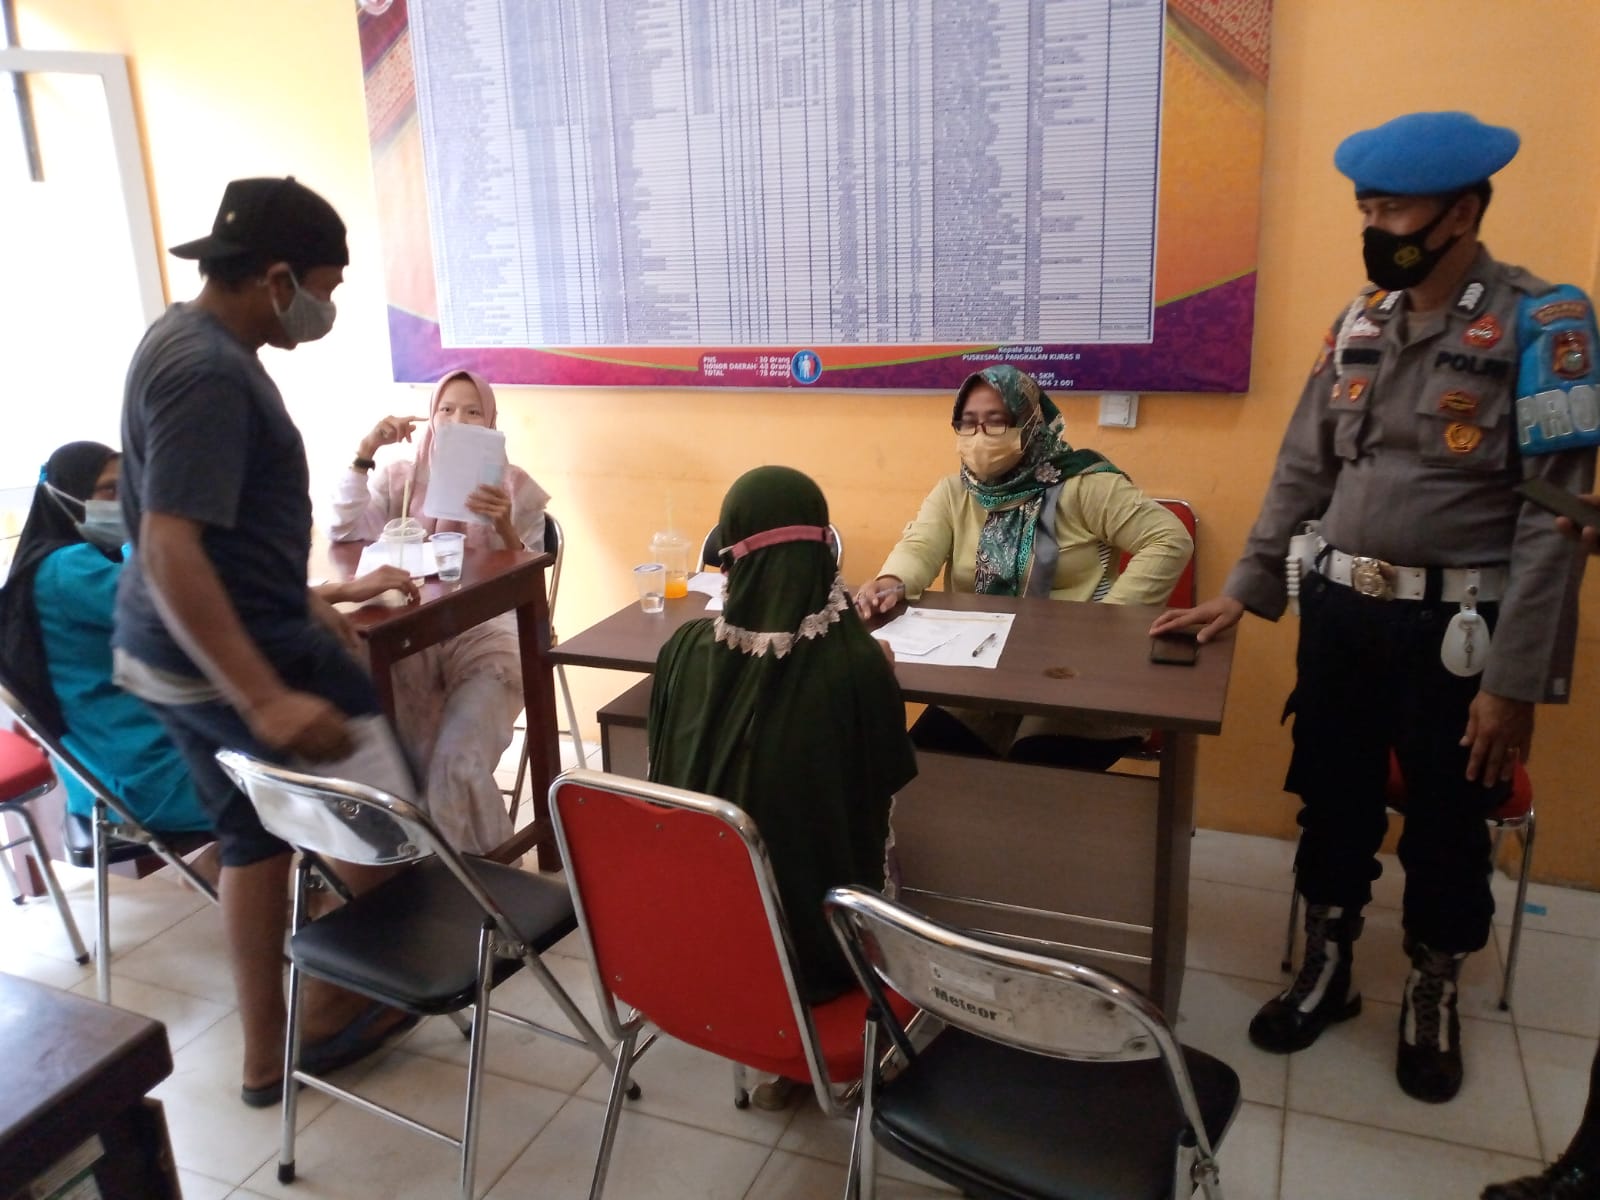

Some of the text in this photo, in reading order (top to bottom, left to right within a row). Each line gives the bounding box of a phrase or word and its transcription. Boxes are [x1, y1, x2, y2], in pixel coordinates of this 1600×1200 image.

[769, 356, 791, 364] Orang
[704, 362, 727, 370] HONOR
[770, 362, 792, 371] Orang
[704, 369, 724, 377] TOTAL
[769, 369, 791, 378] Orang
[1038, 372, 1056, 380] SKM
[1516, 384, 1600, 446] PRO
[934, 986, 998, 1021] Meteor
